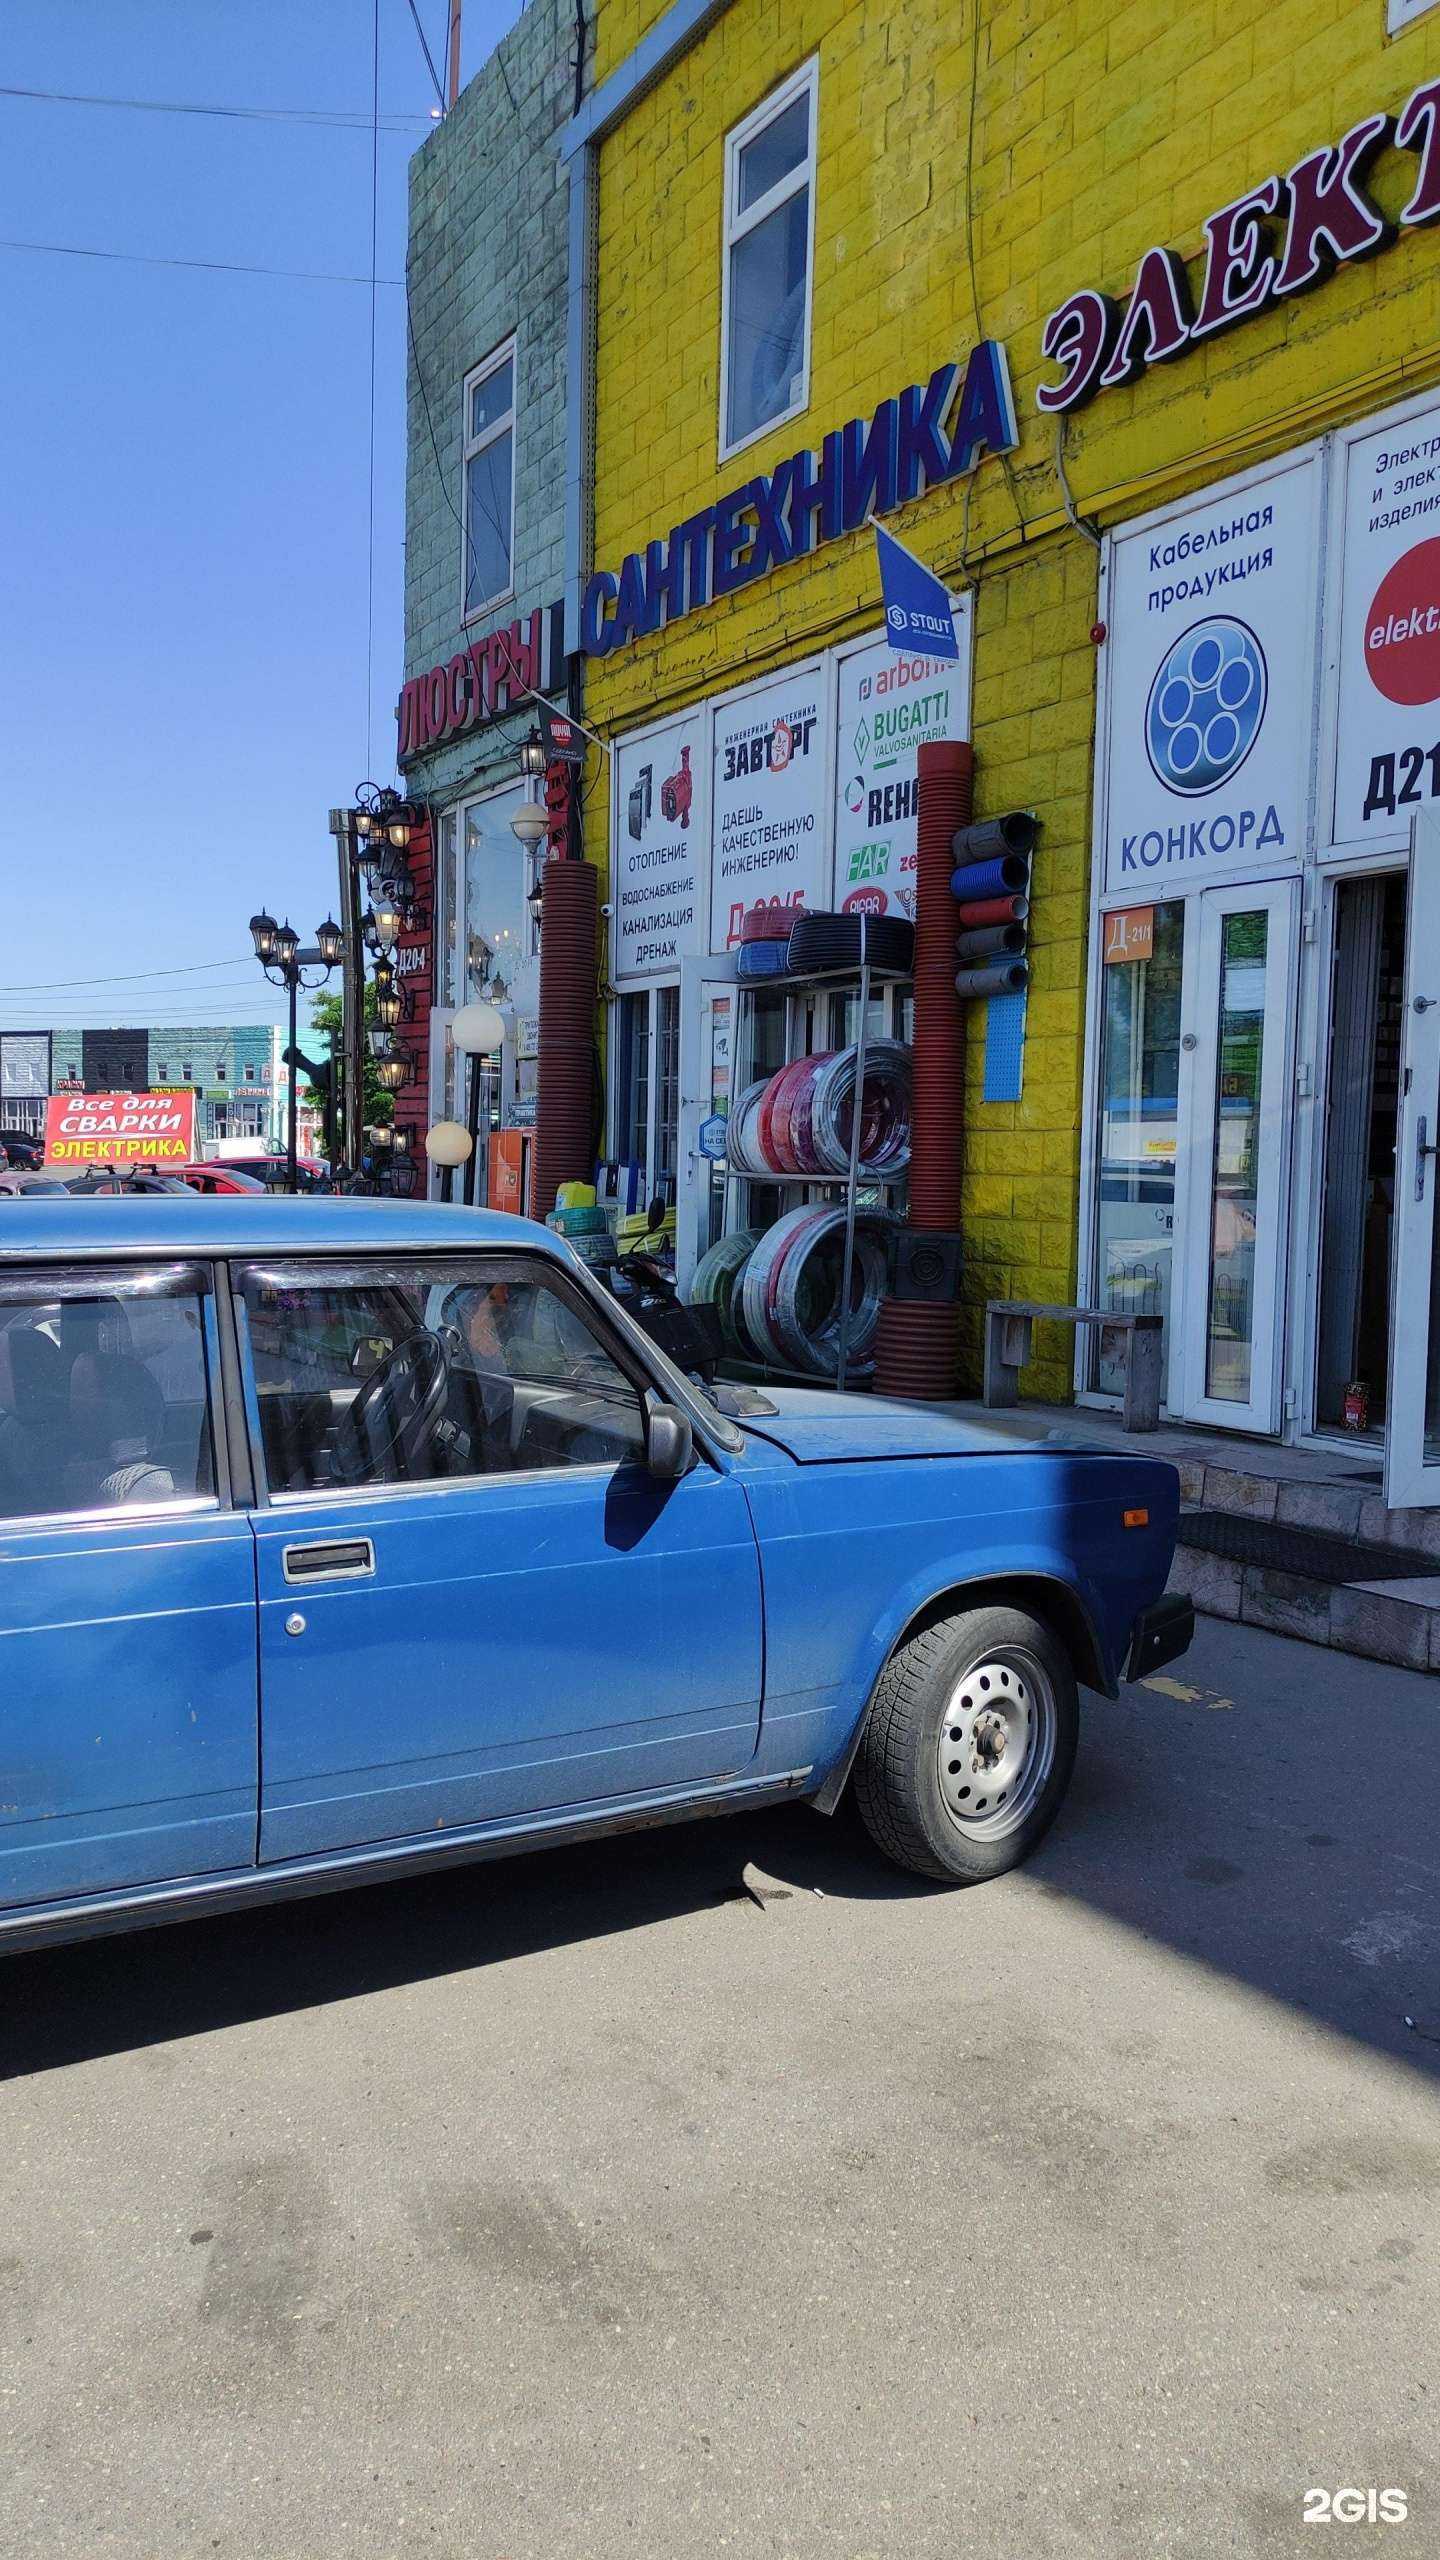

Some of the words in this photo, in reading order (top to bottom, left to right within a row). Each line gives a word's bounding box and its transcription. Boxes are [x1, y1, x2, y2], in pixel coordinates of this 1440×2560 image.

[577, 340, 1019, 657] САНТЕХНИКА
[1372, 487, 1383, 504] и
[1150, 504, 1274, 572] Кабельная
[1147, 547, 1274, 612] продукция
[910, 612, 951, 634] STOUT
[398, 607, 546, 757] ЛЮСТРЫ
[874, 689, 949, 741] BUGATTI
[874, 725, 947, 758] VALVOSANITARIA
[721, 805, 763, 834] ДАЕШЬ
[722, 814, 815, 854] КАЧЕСТВЕННУЮ
[1121, 804, 1285, 872] КОНКОРД
[628, 842, 688, 873] ОТОПЛЕНИЕ
[722, 843, 800, 877] ИНЖЕНЕРИЮ!
[847, 841, 891, 881] FAR
[622, 877, 694, 906] ВОДОСНАБЖЕНИЕ
[622, 907, 693, 937] КАНАЛИЗАЦИЯ
[636, 940, 677, 966] ДРЕНАЖ
[67, 1098, 114, 1112] Все
[122, 1096, 173, 1111] для
[59, 1113, 182, 1133] СВАРКИ
[50, 1139, 188, 1158] ЭЛЕКТРИКА
